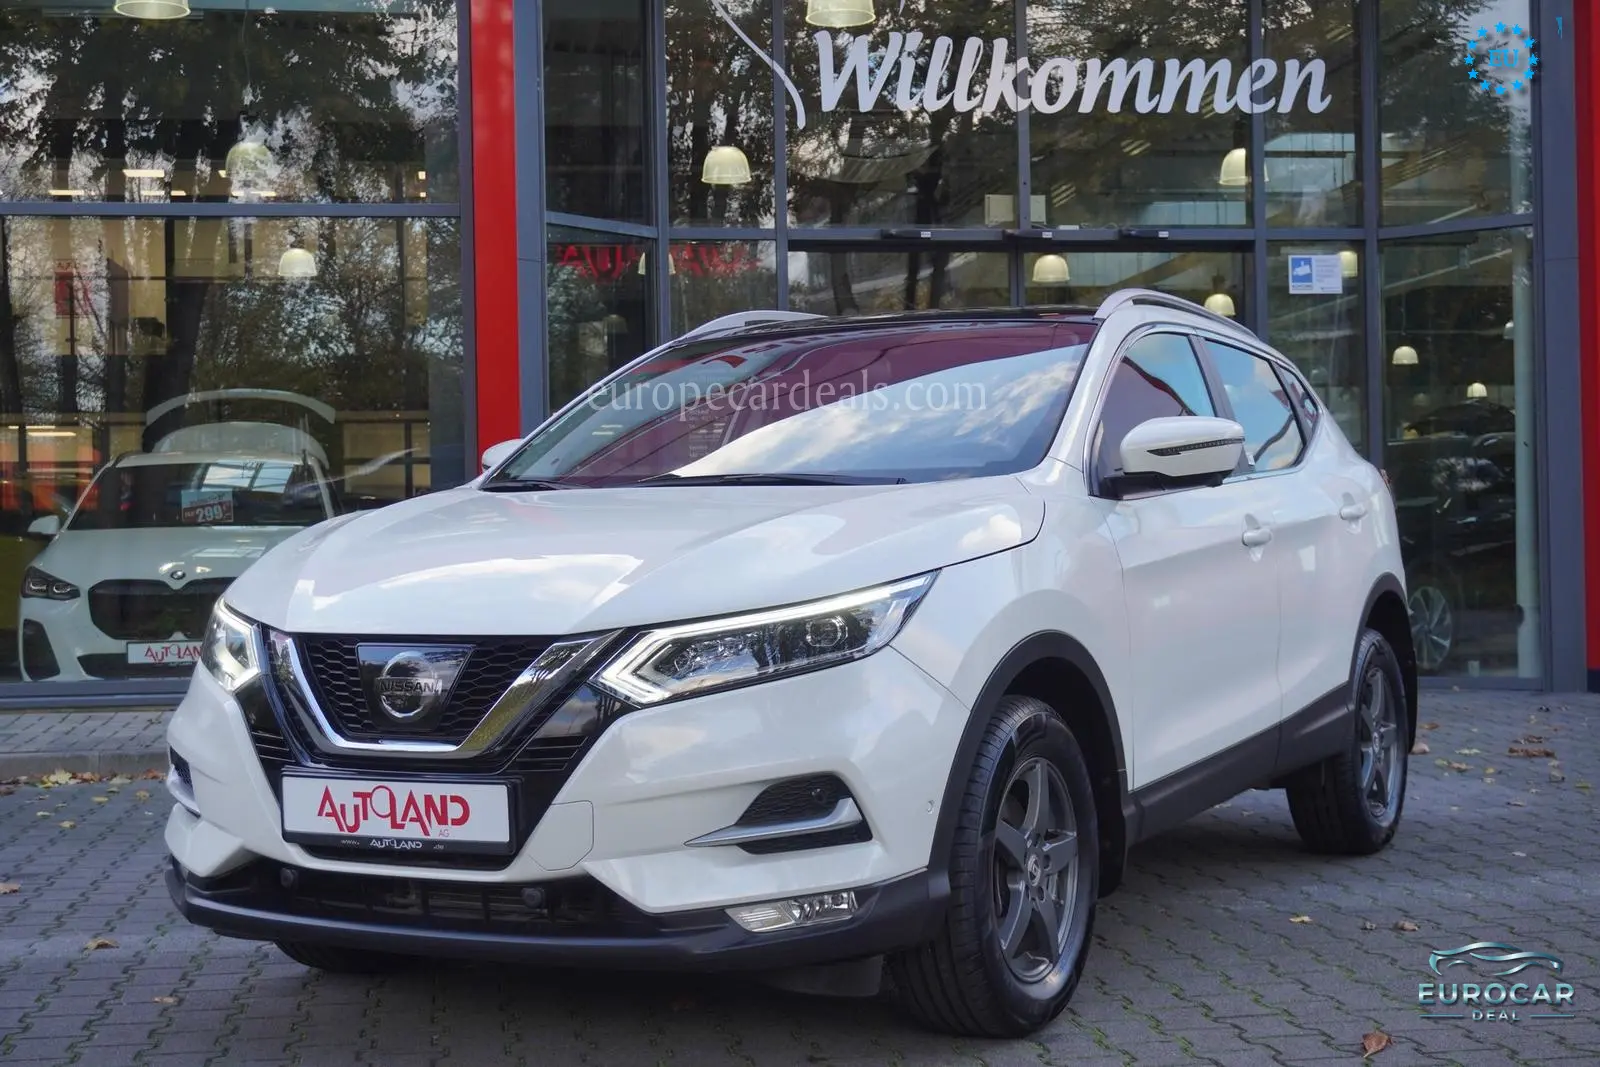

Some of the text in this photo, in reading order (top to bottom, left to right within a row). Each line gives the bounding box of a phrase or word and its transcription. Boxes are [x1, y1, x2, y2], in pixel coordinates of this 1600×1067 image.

[813, 29, 1332, 115] Willkommen
[144, 644, 202, 662] AUTOLAN
[380, 679, 434, 693] NISSAN
[317, 784, 471, 837] AUTOLAND
[438, 828, 450, 838] AG
[370, 838, 423, 850] AUTOLAND
